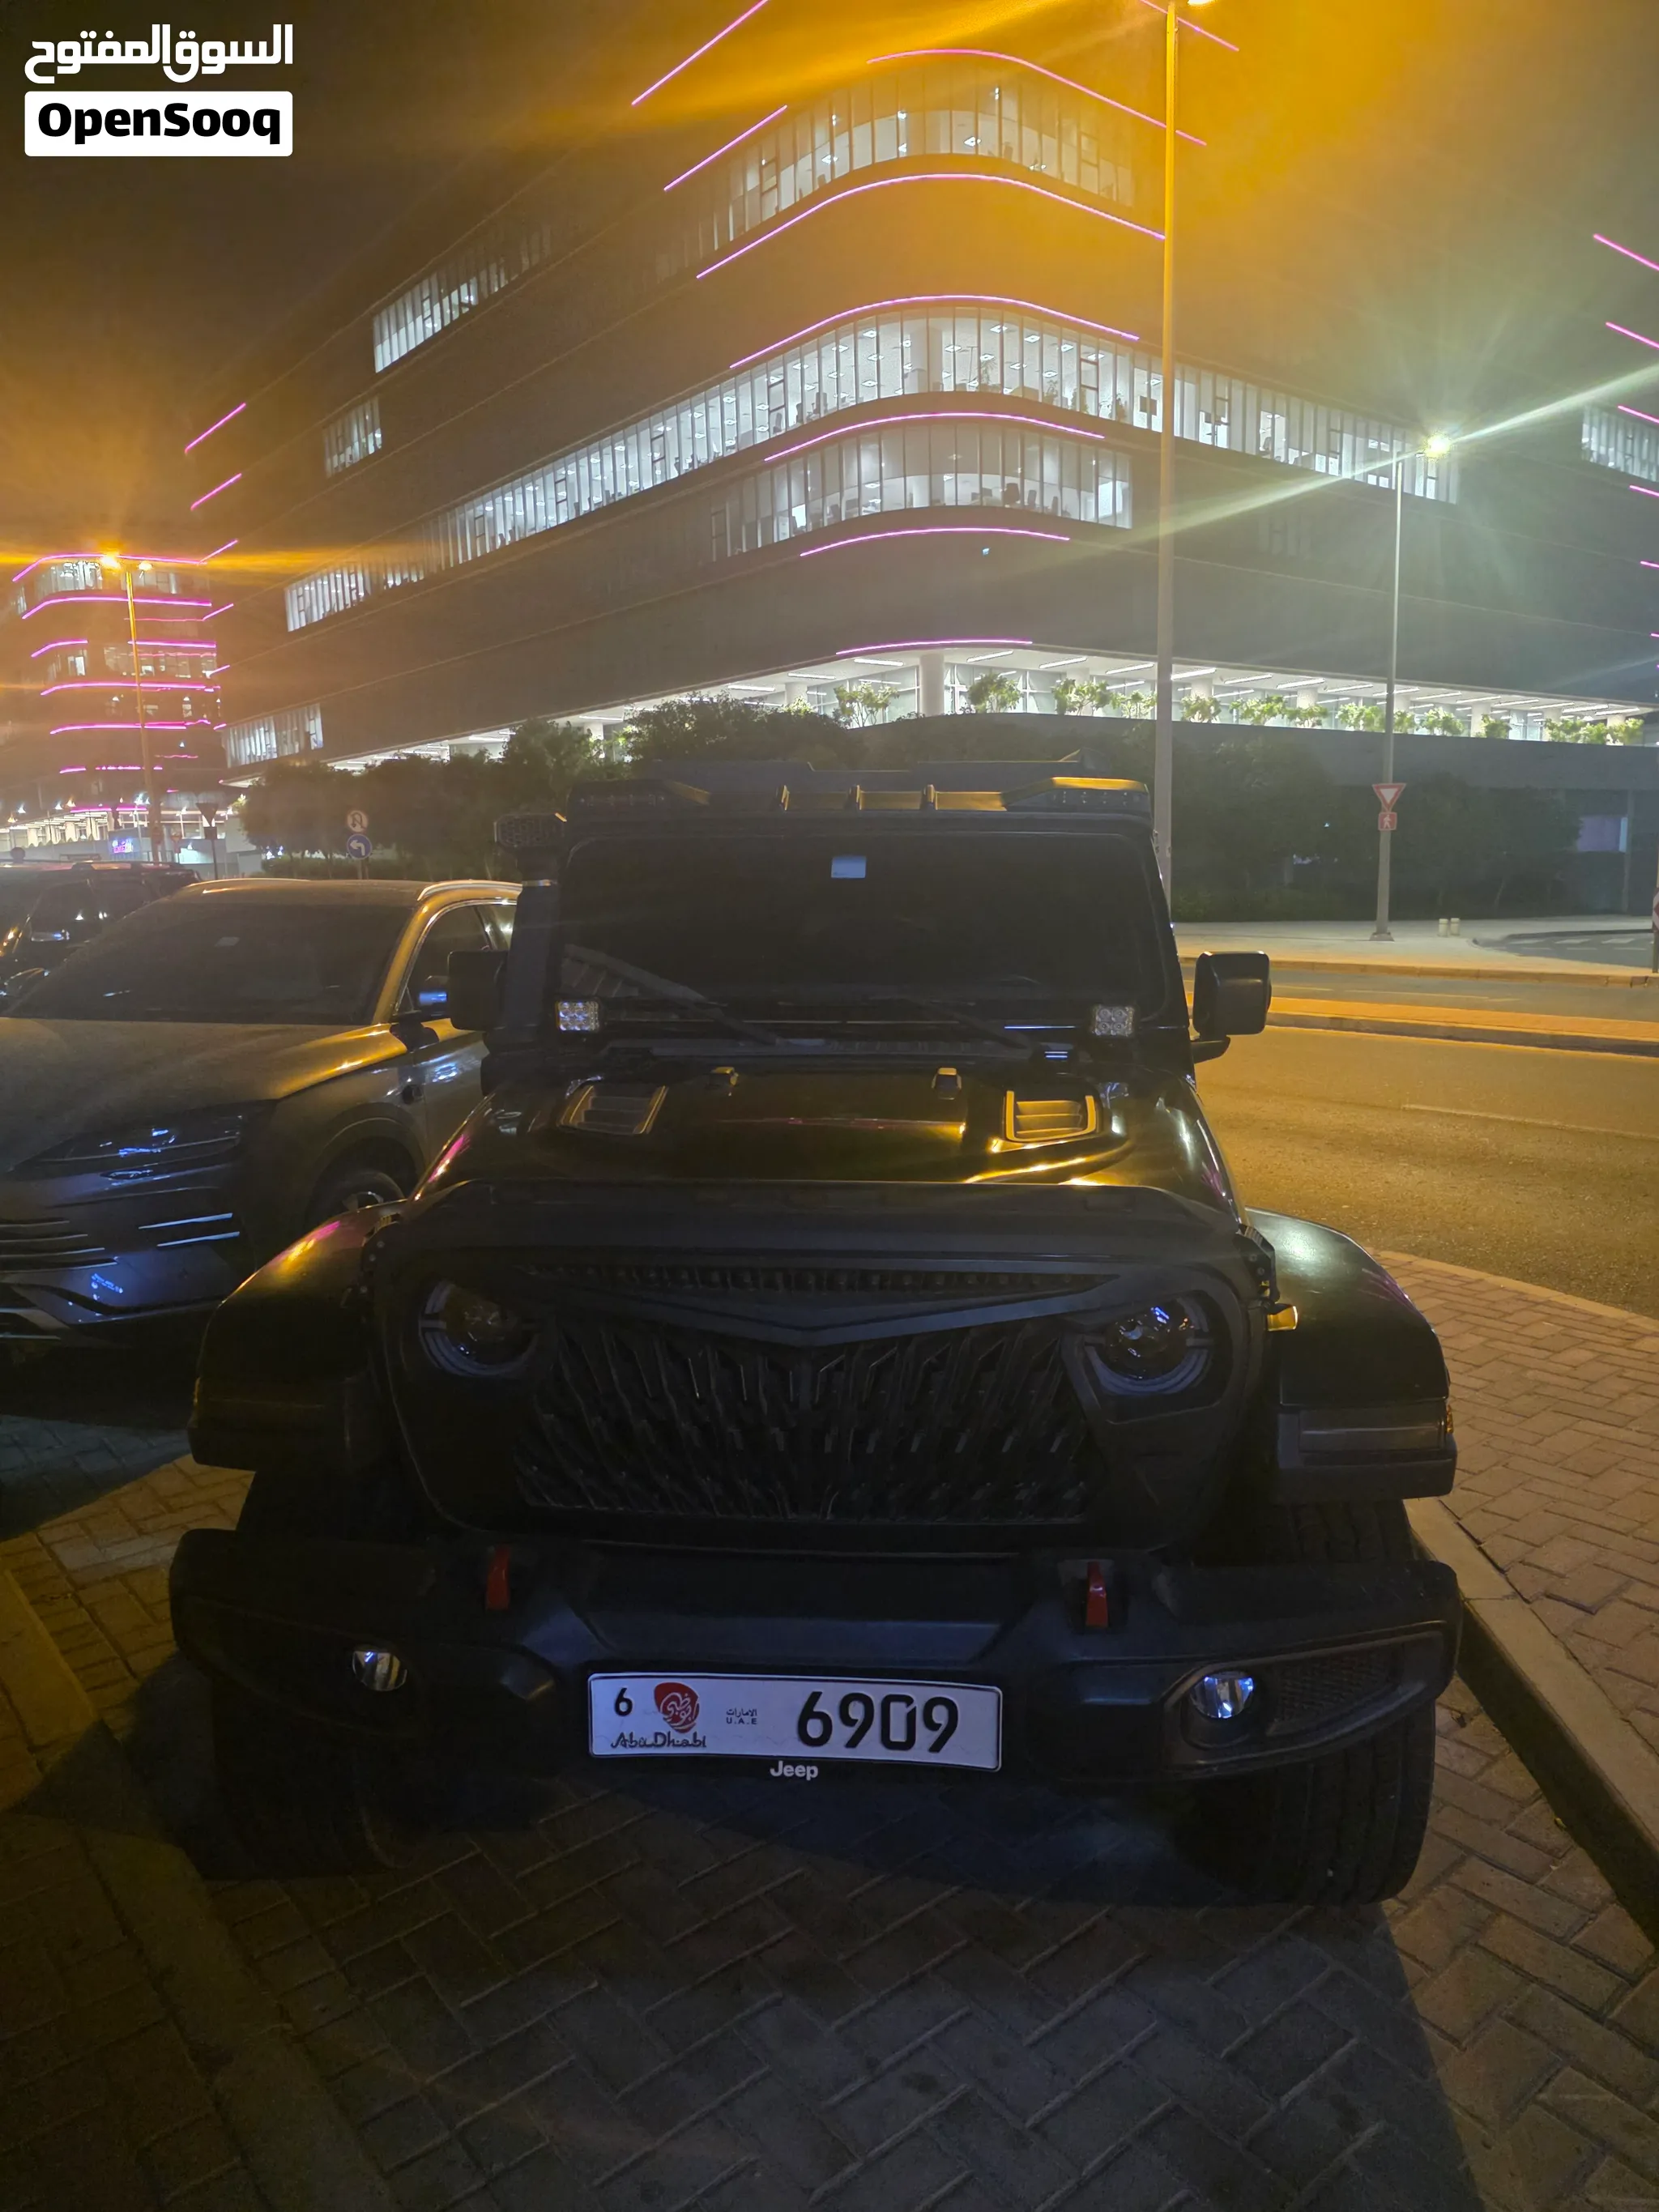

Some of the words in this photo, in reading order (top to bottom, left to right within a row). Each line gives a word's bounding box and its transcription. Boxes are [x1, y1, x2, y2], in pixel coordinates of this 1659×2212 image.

[614, 1687, 633, 1716] 6
[797, 1690, 959, 1754] 6909
[770, 1760, 818, 1780] Jeep
